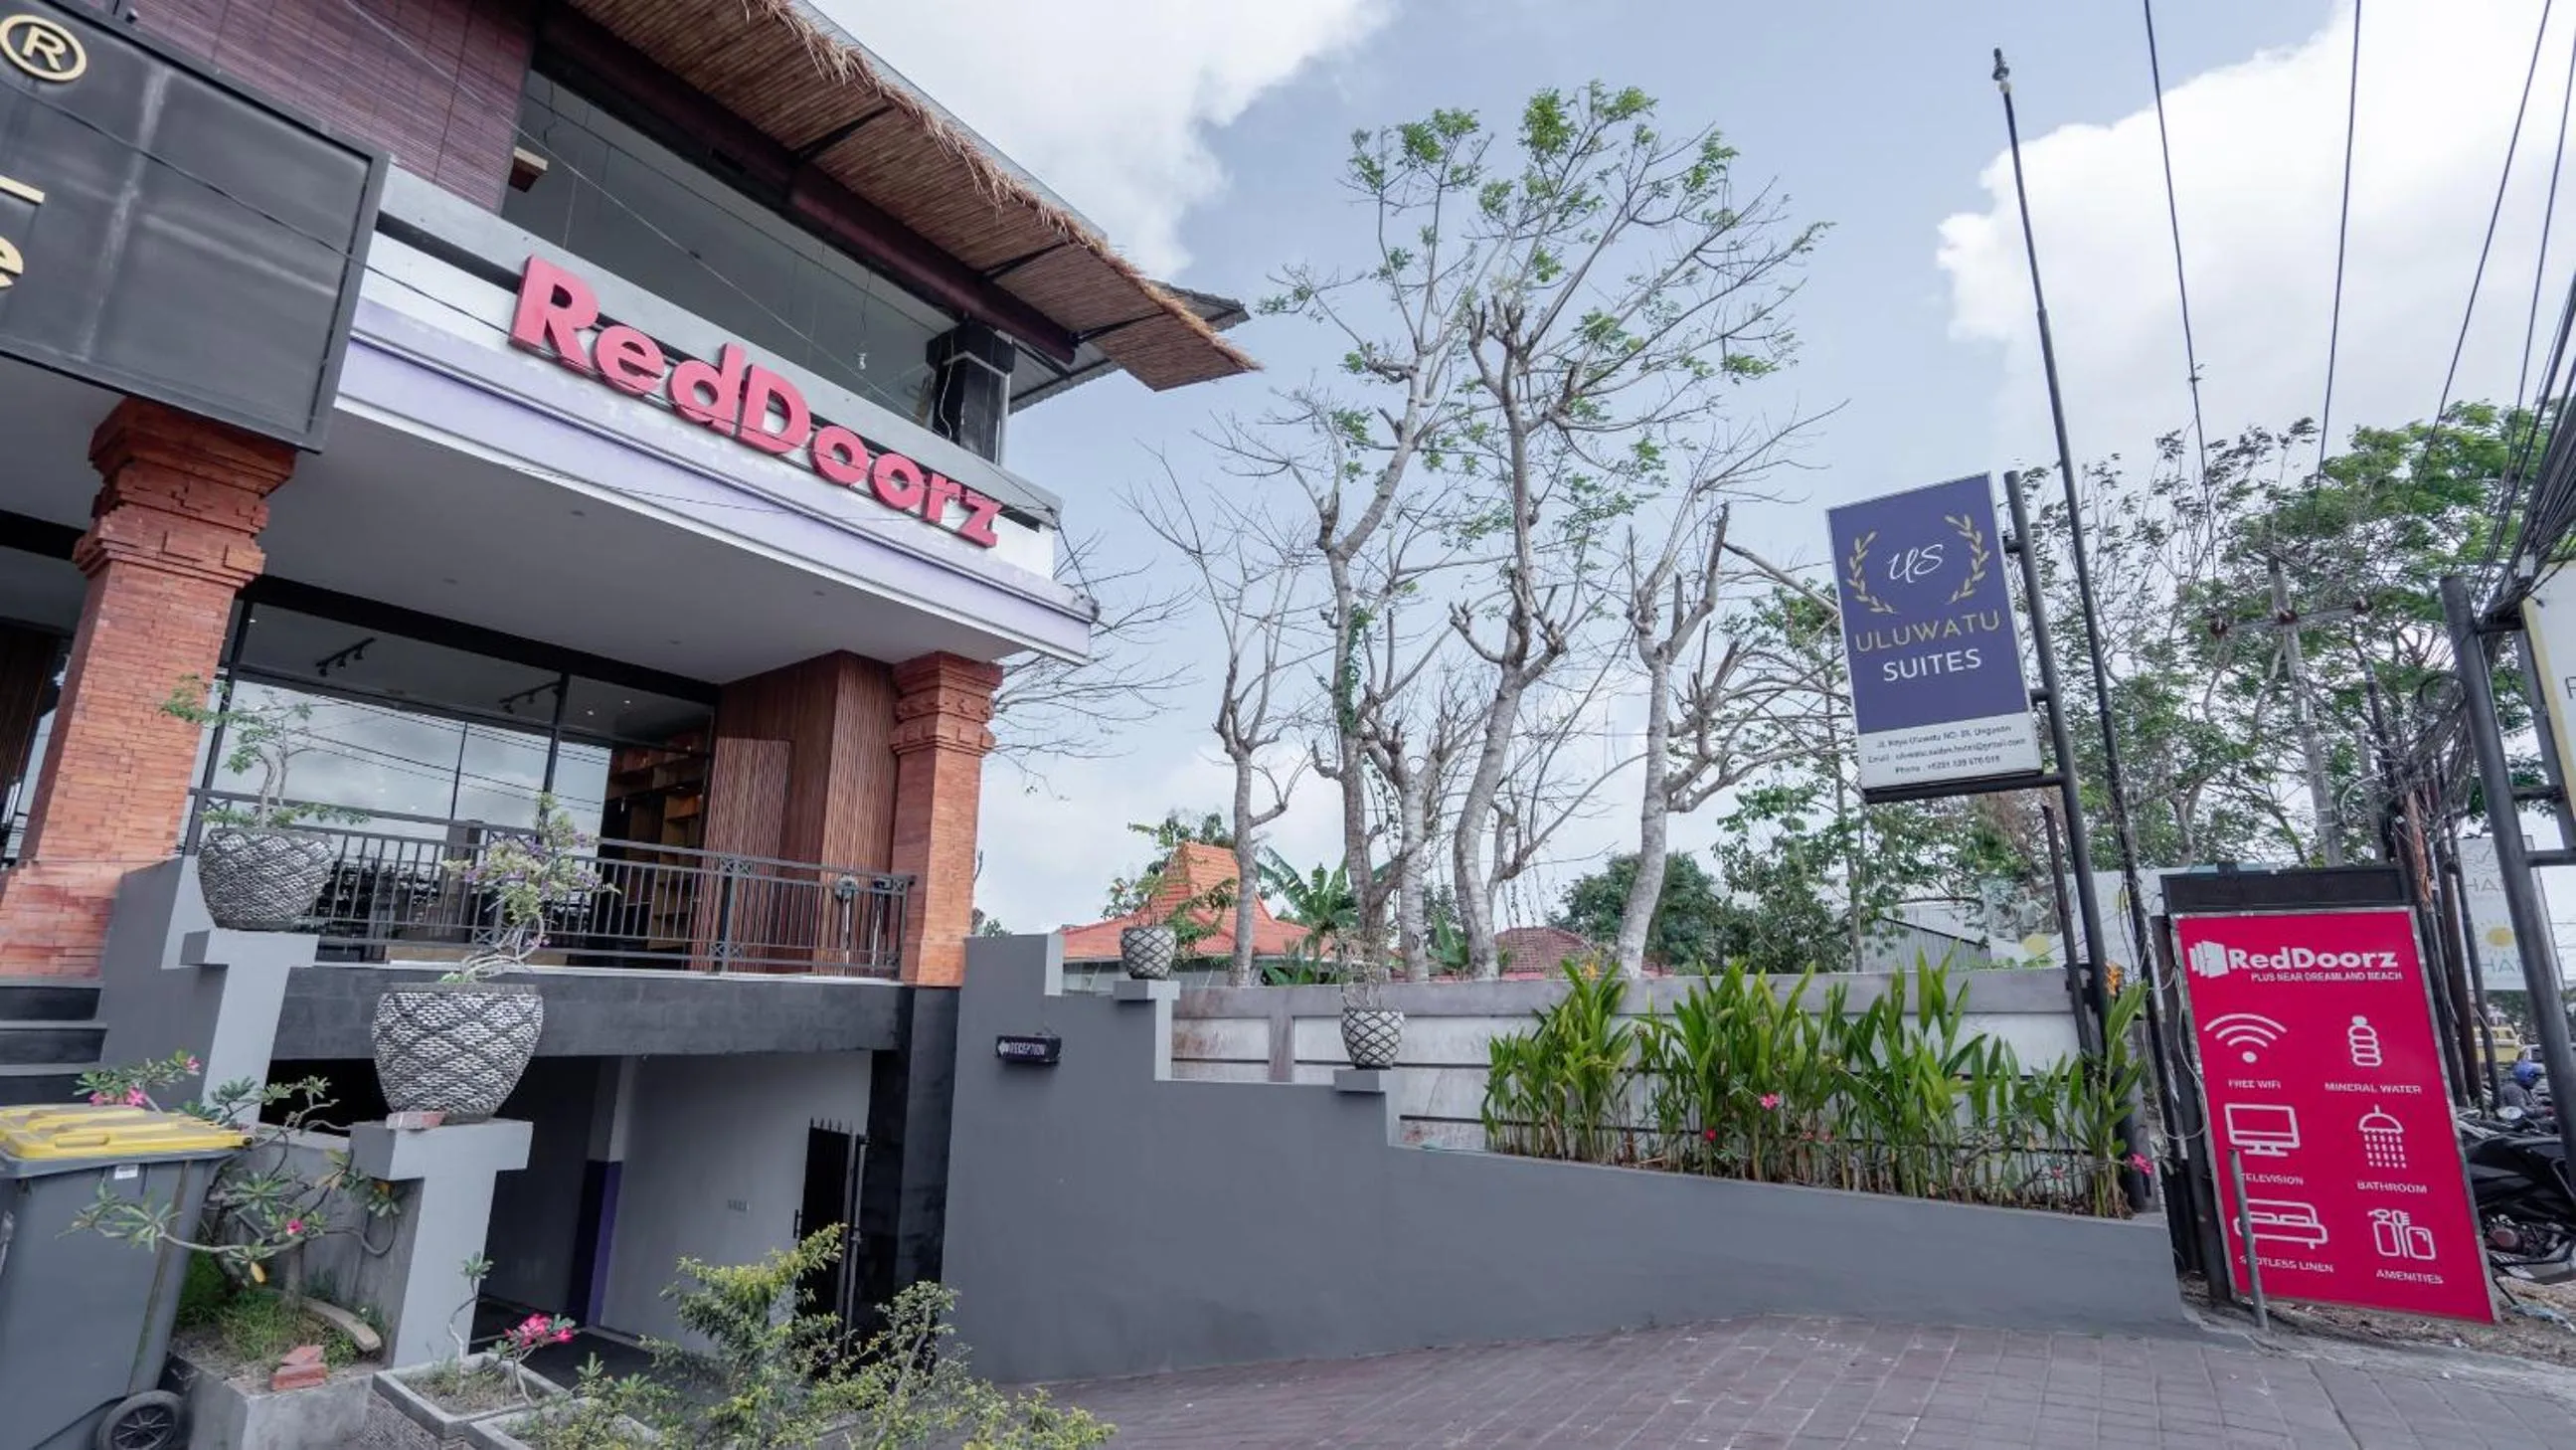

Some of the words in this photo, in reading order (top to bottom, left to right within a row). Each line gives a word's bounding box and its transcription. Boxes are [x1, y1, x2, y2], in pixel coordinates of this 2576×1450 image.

[508, 253, 1002, 548] RedDoorz
[1855, 610, 2000, 652] ULUWATU
[1883, 648, 1981, 681] SUITES
[2228, 947, 2399, 970] RedDoorz
[2251, 973, 2276, 983] PLUS
[2278, 972, 2303, 982] NEAR
[2305, 971, 2365, 982] DREAMLAND
[2367, 971, 2403, 981] BEACH
[2228, 1079, 2255, 1089] FREE
[2324, 1082, 2378, 1093] MINERAL
[2380, 1084, 2422, 1094] WATER
[2357, 1179, 2428, 1193] BATHROOM
[2239, 1255, 2298, 1269] SOTLESS
[2299, 1261, 2334, 1273] LINEN
[2376, 1269, 2444, 1285] AMENITIES
